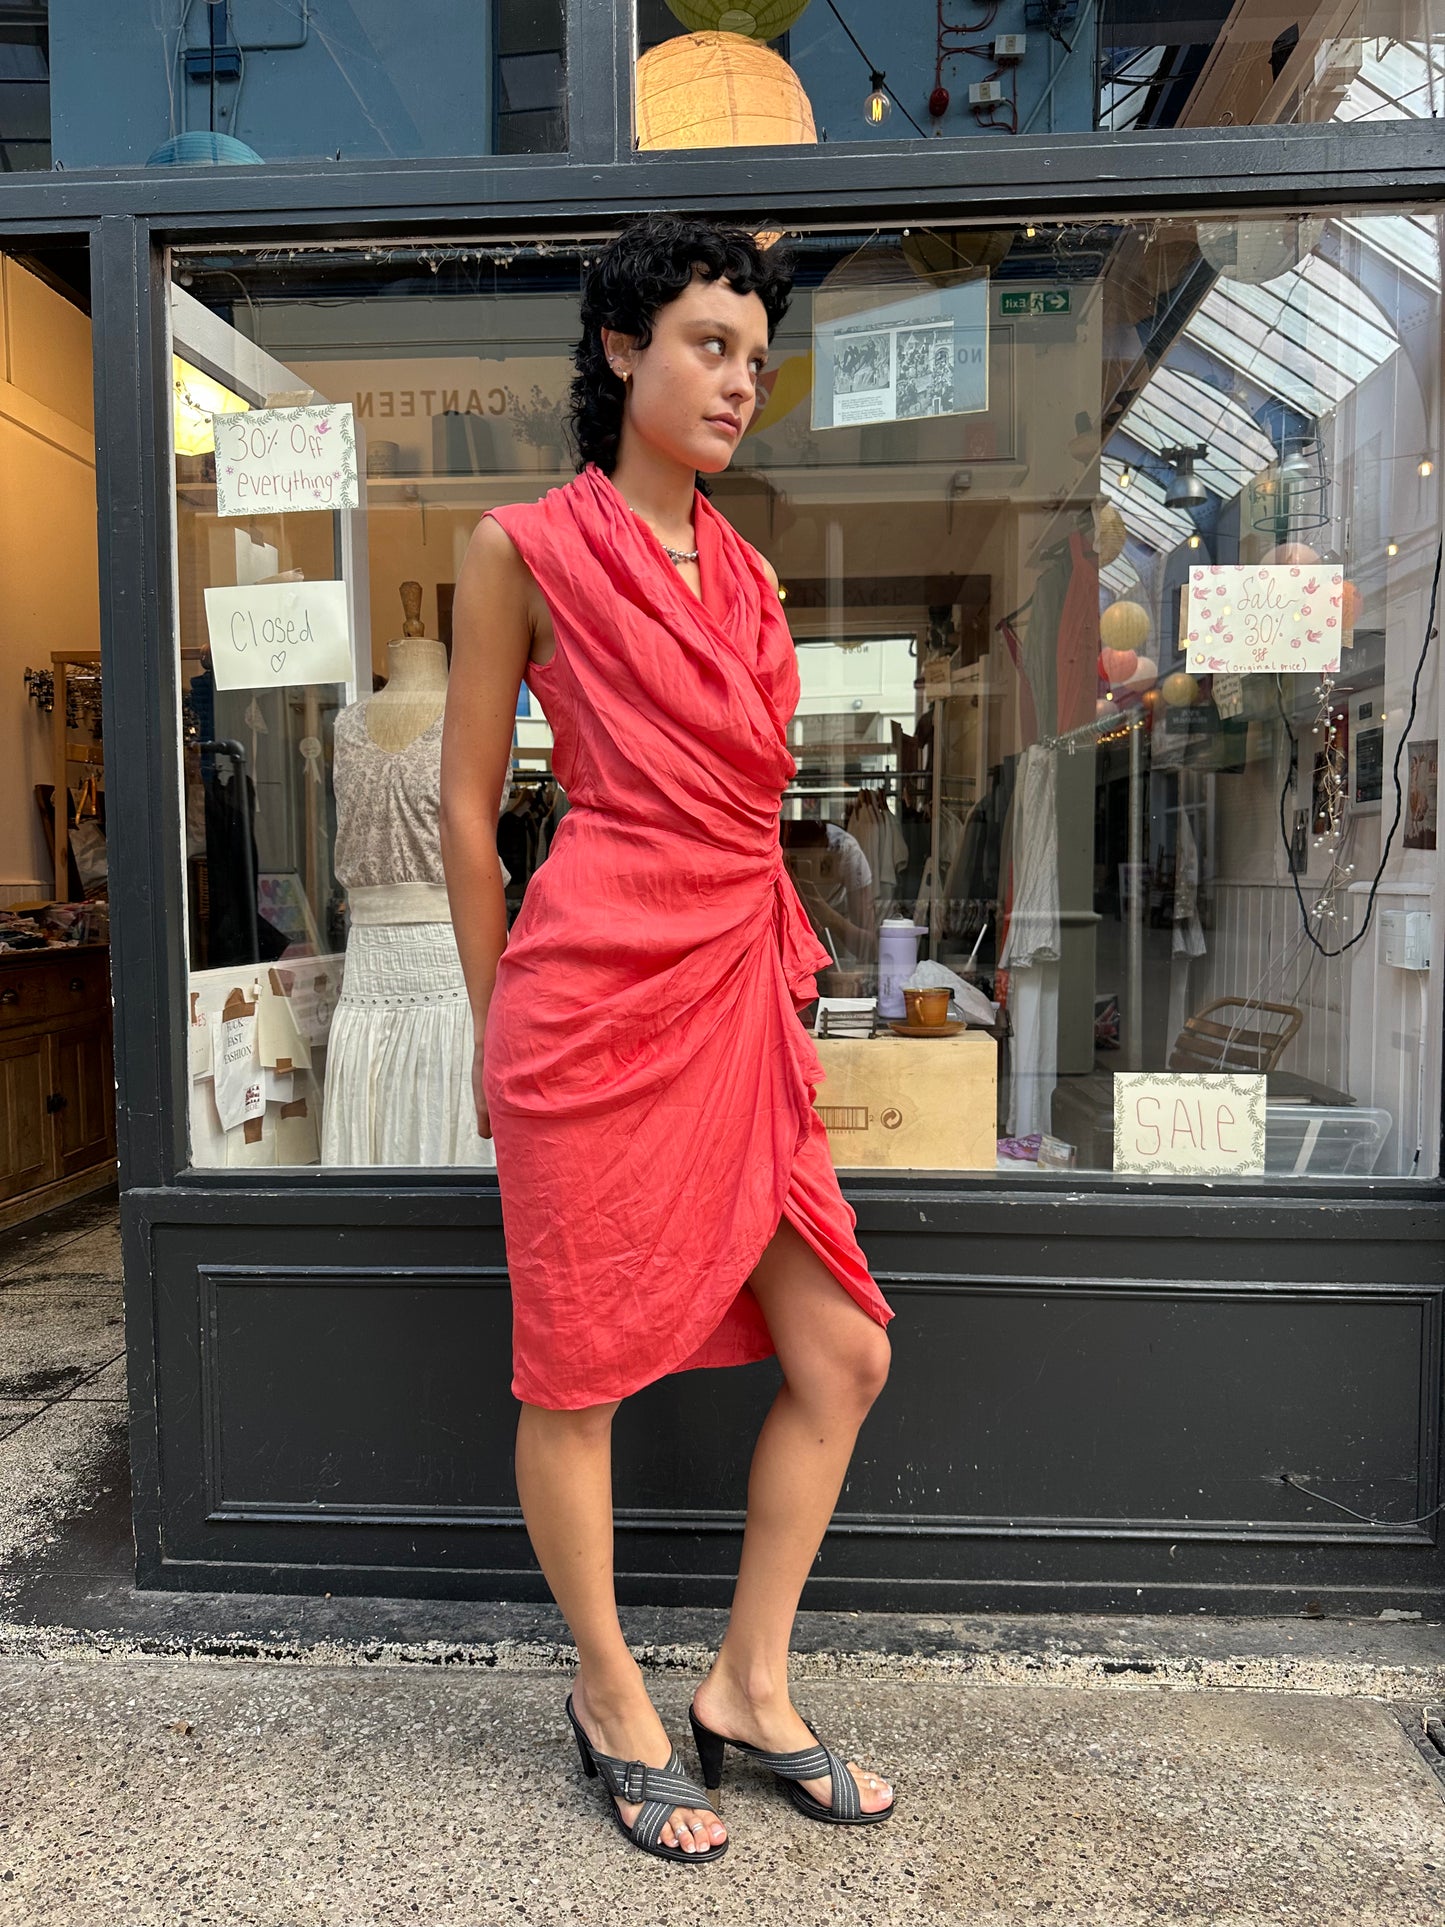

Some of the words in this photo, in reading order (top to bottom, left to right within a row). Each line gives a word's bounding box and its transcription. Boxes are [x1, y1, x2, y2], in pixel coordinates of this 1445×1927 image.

[228, 423, 279, 462] 30%
[236, 469, 333, 503] everything
[1236, 576, 1299, 611] Sale
[231, 609, 314, 652] Closed
[1244, 613, 1284, 646] 30%
[1251, 647, 1268, 663] off
[223, 1044, 253, 1065] FASHION
[227, 1033, 243, 1048] FAST
